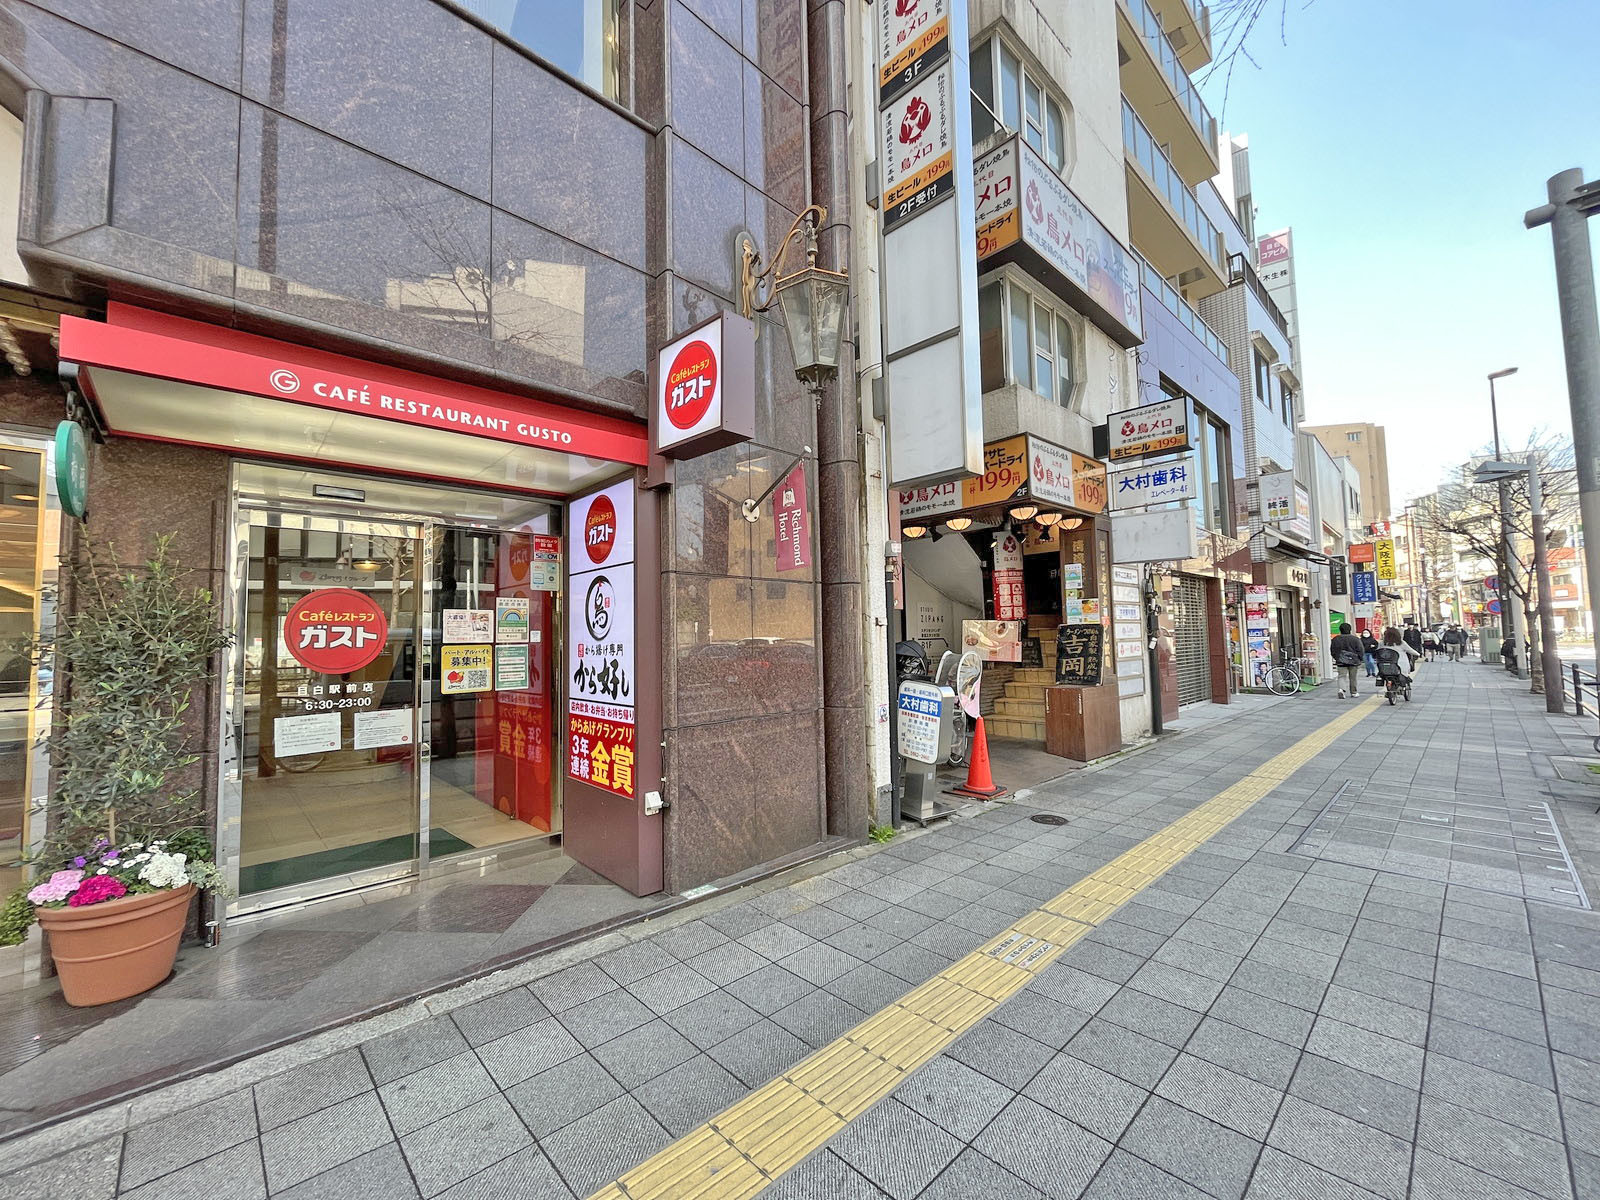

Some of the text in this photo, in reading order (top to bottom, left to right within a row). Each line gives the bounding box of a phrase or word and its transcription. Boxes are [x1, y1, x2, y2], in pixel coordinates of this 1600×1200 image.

[896, 12, 928, 46] 鳥メロ
[883, 47, 917, 80] 生ビール
[904, 58, 922, 83] 3F
[900, 143, 933, 173] 鳥メロ
[887, 177, 921, 205] 生ビール
[899, 184, 938, 218] 2F受付
[976, 175, 1012, 211] メロ
[1046, 212, 1084, 265] 鳥メロ
[670, 375, 713, 410] ガスト
[312, 382, 371, 405] CAFÉ
[380, 394, 510, 432] RESTAURANT
[516, 423, 572, 444] GUSTO
[1137, 418, 1173, 435] 鳥メロ
[1114, 443, 1151, 457] 生ビール
[916, 480, 955, 503] 鳥メロ
[1016, 487, 1028, 497] 2F
[1045, 469, 1070, 490] 鳥メロ
[1118, 465, 1188, 493] 大村歯科
[1151, 484, 1188, 498] エレベーター4F
[588, 524, 614, 546] ガスト
[778, 507, 805, 567] Richmond Hotel
[1378, 542, 1393, 578] 大阪王将
[299, 610, 375, 622] Caféレストラン
[299, 624, 379, 649] ガスト
[450, 656, 486, 668] 募集中!
[1061, 634, 1088, 676] 吉岡
[297, 682, 374, 697] 目白駅前店
[573, 657, 630, 701] から好し
[901, 696, 939, 716] 大村歯科
[571, 735, 590, 758] 3年
[590, 740, 634, 795] 金賞
